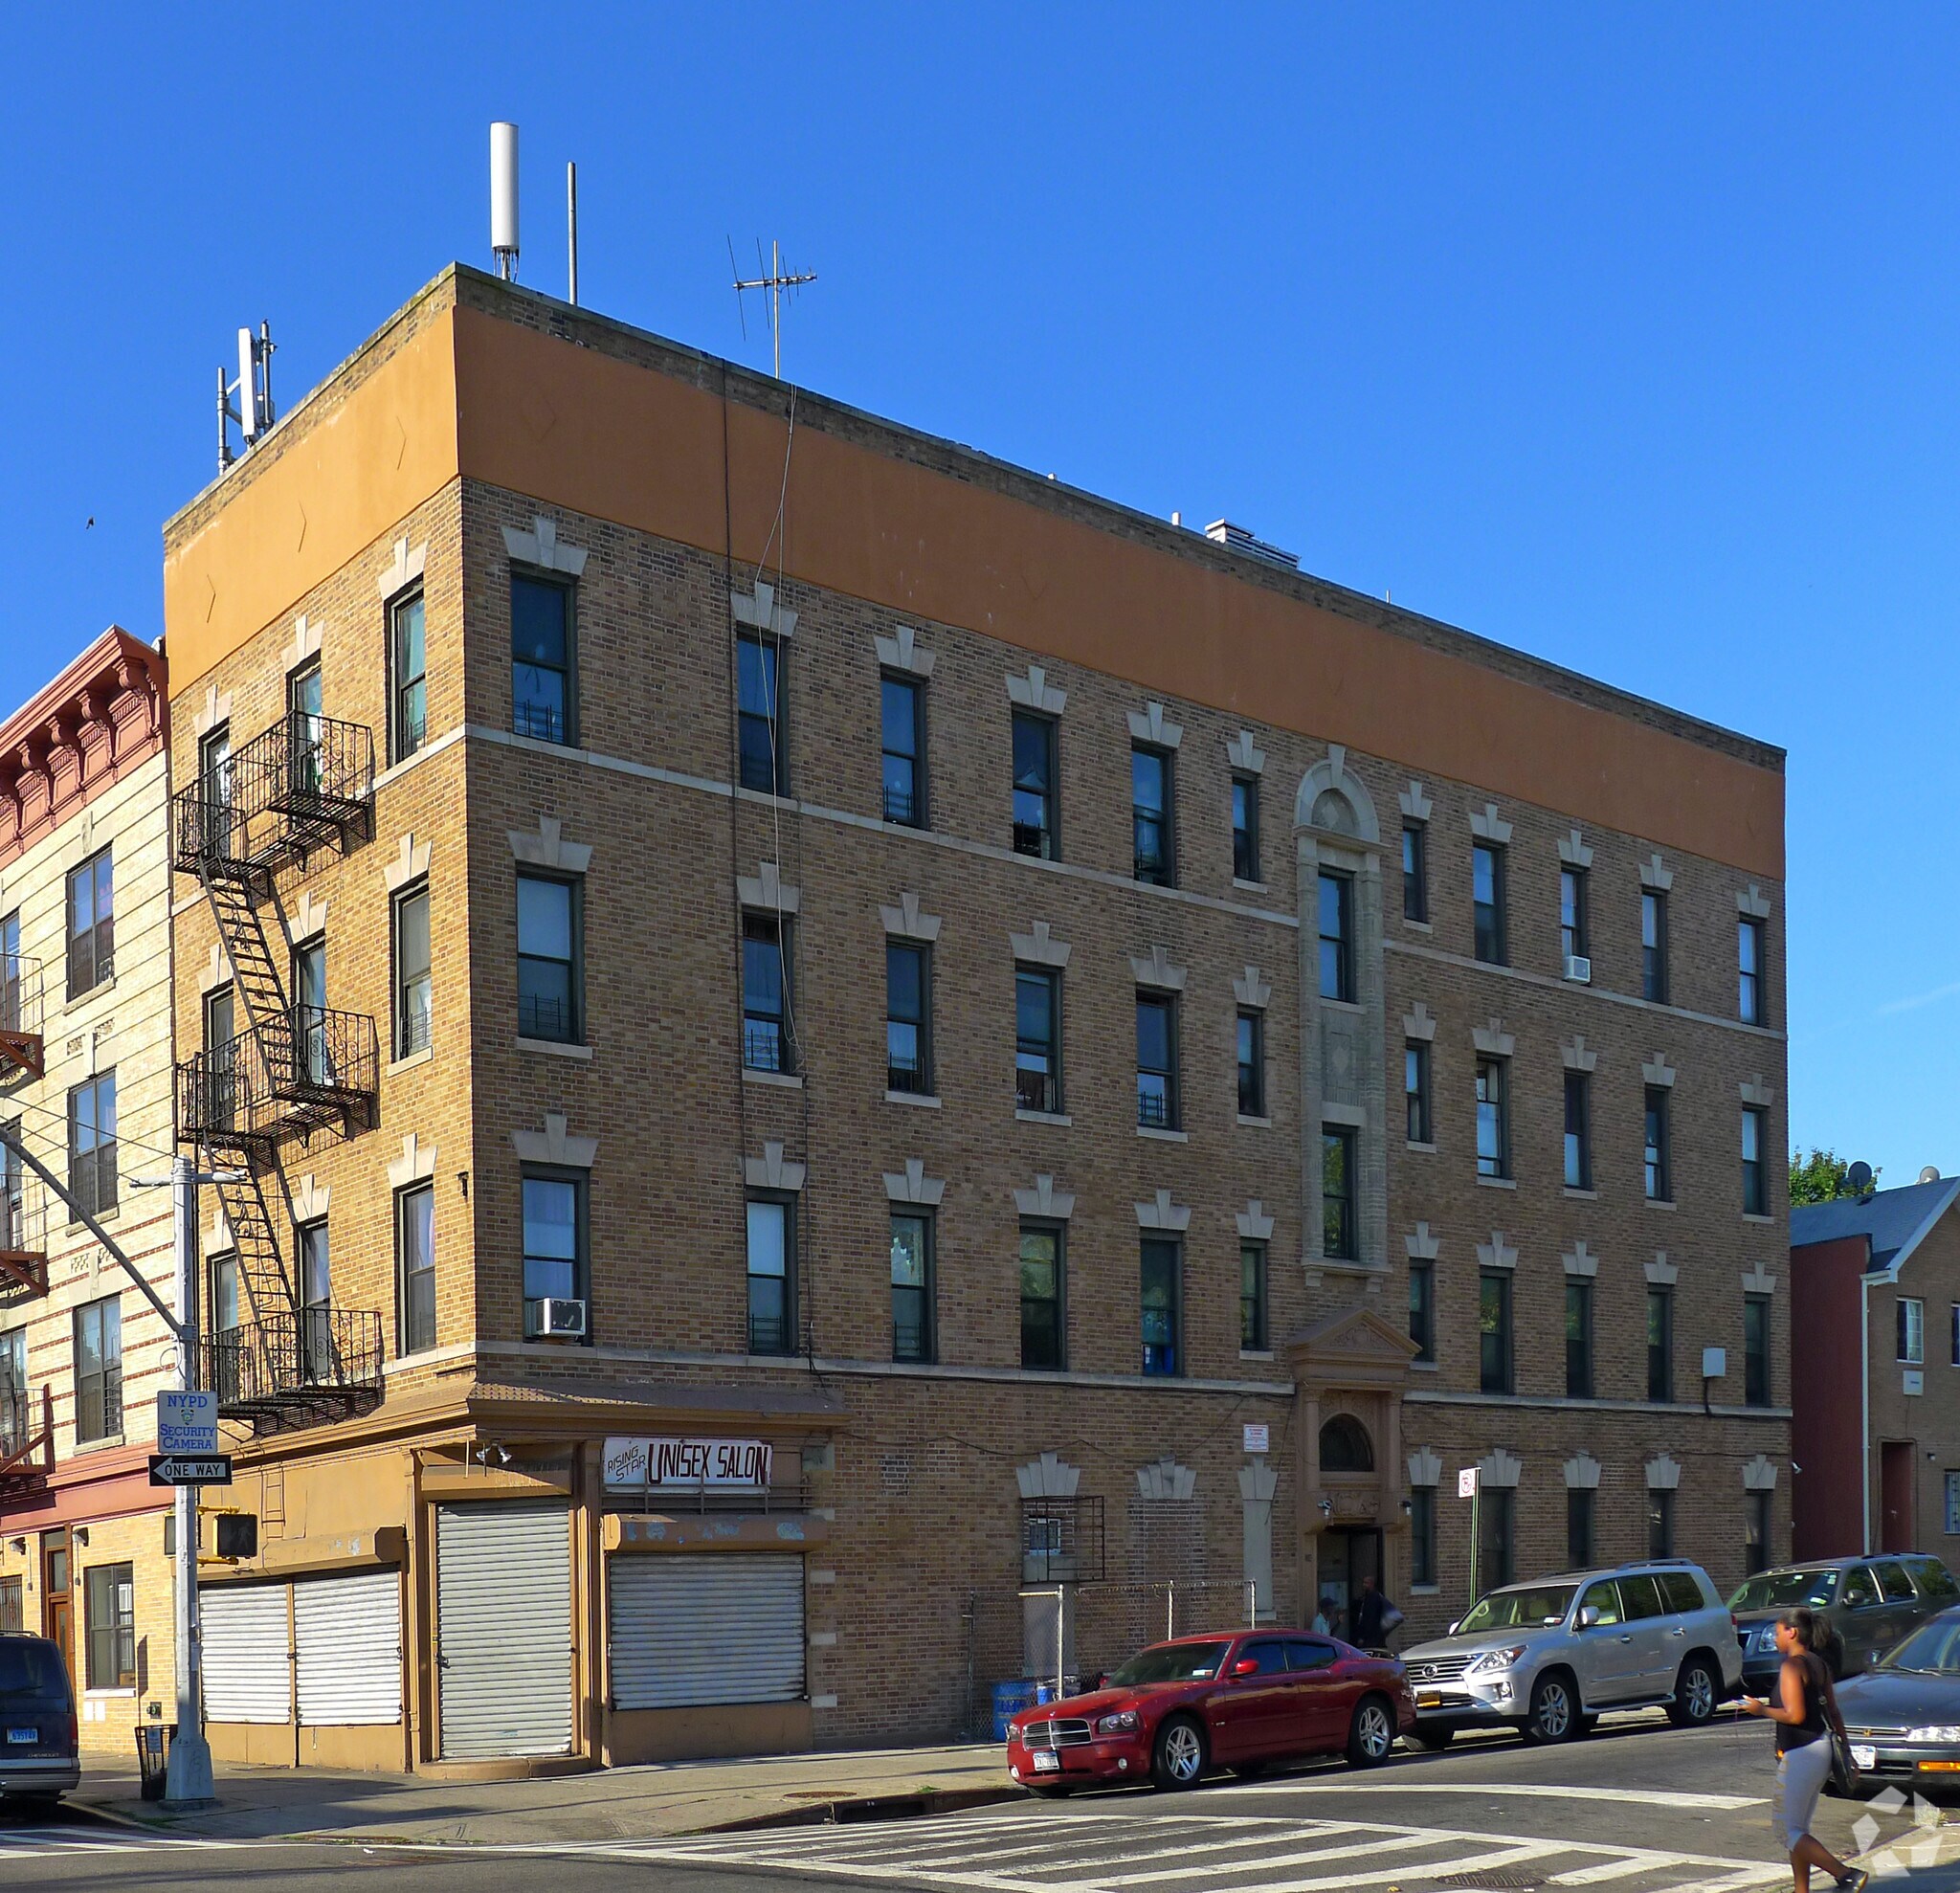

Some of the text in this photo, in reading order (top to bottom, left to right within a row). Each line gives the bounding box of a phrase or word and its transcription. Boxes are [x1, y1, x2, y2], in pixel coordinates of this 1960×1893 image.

[167, 1395, 208, 1408] NYPD
[160, 1424, 215, 1436] SECURITY
[163, 1436, 212, 1449] CAMERA
[608, 1445, 639, 1473] RISING
[648, 1443, 768, 1484] UNISEX SALON
[165, 1464, 220, 1477] ONE WAY
[615, 1454, 646, 1481] STAR
